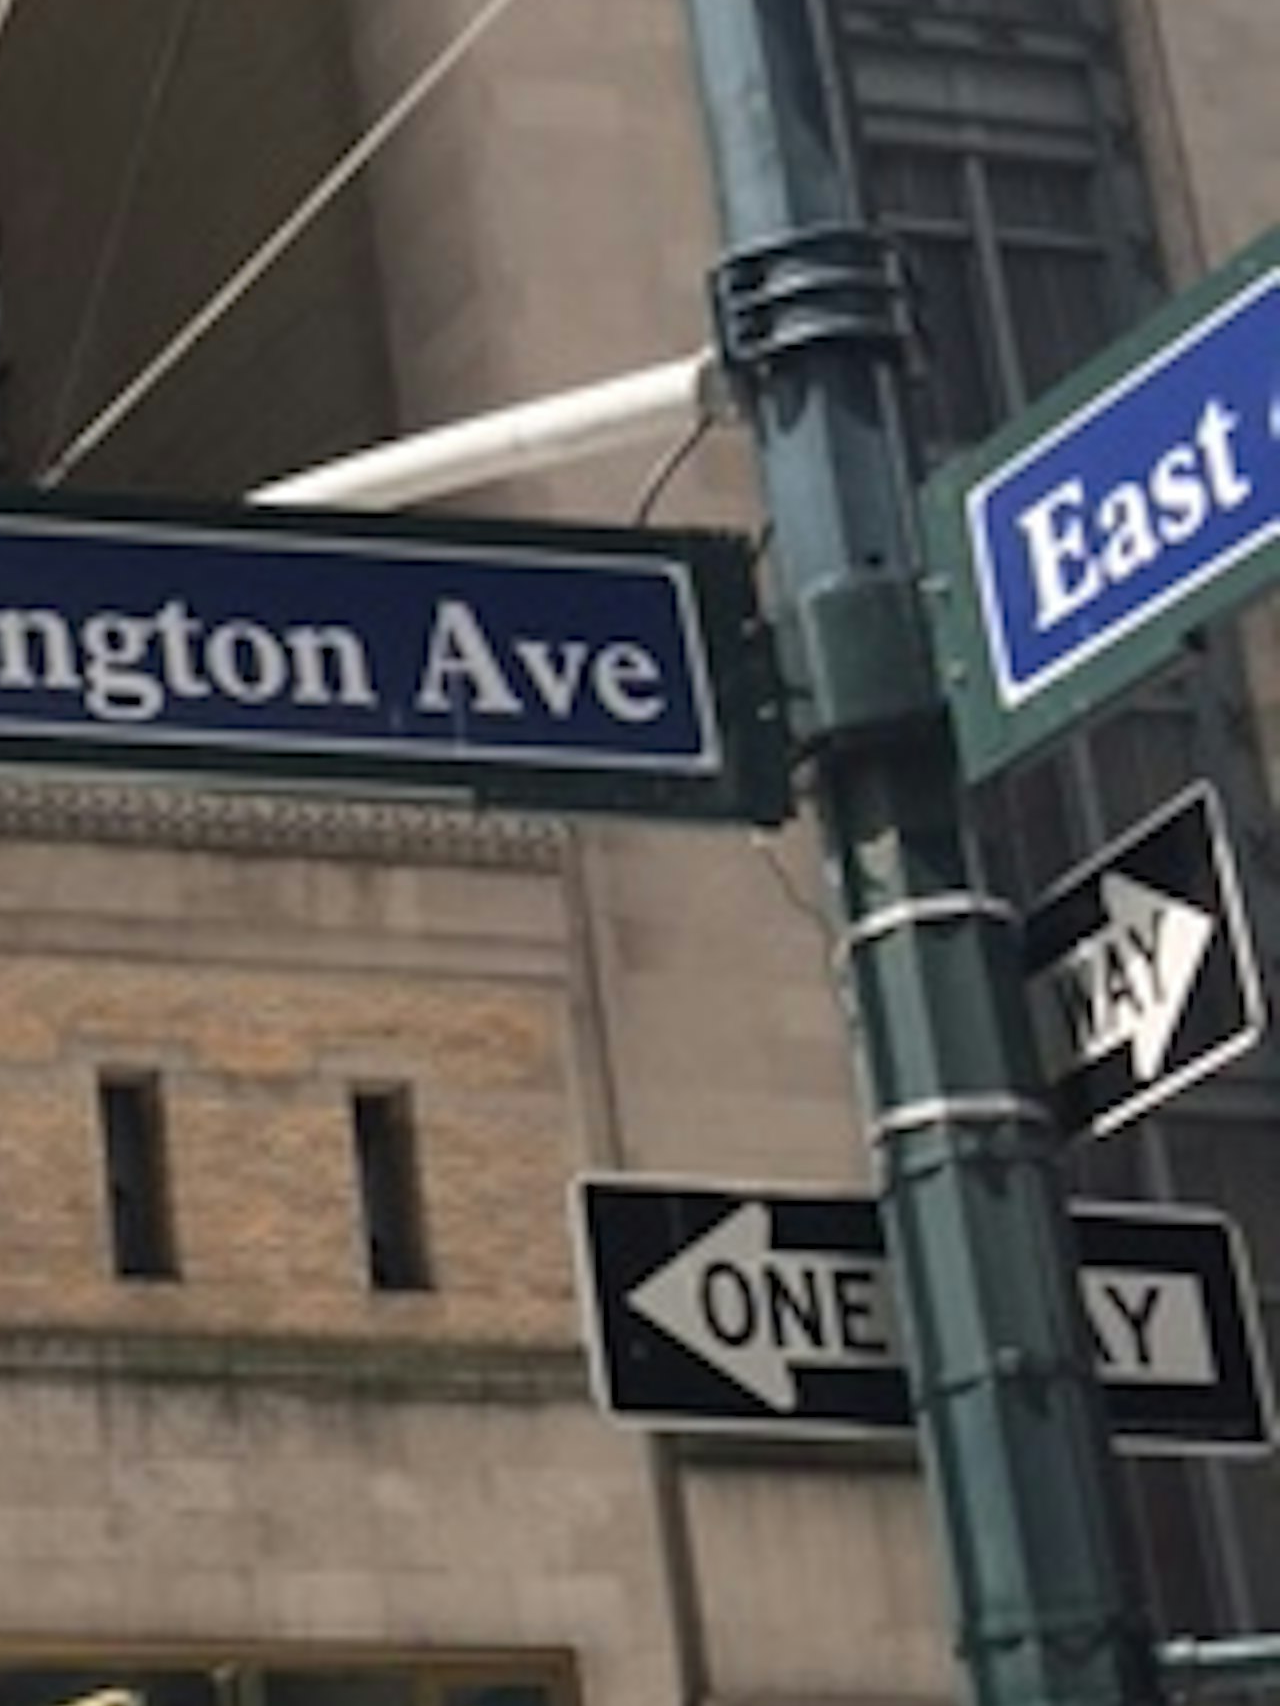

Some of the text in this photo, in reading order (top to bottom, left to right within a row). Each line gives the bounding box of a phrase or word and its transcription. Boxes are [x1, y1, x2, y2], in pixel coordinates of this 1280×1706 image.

[1017, 398, 1252, 633] East
[417, 600, 662, 719] Ave
[700, 1260, 888, 1353] ONE
